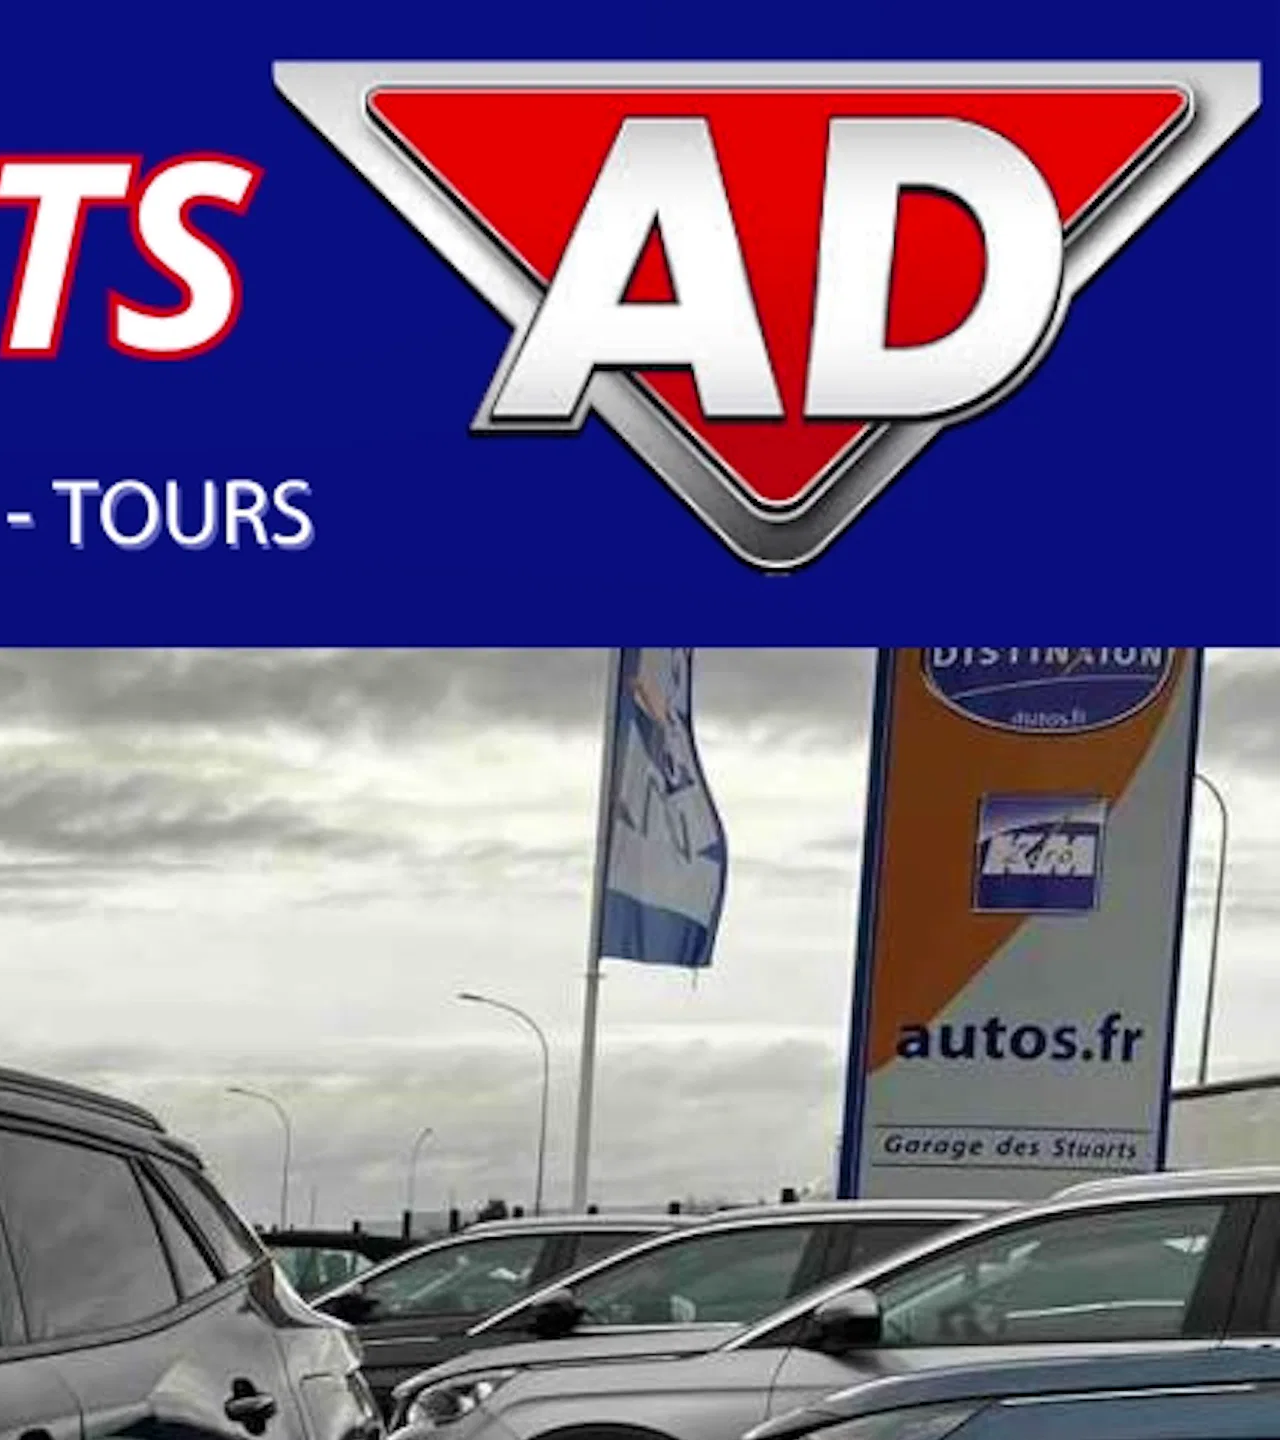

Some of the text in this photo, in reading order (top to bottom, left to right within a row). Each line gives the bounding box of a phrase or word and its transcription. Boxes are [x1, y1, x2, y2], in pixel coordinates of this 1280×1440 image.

[896, 1013, 1144, 1062] autos.fr
[884, 1135, 1137, 1160] Garage des Stuarts
